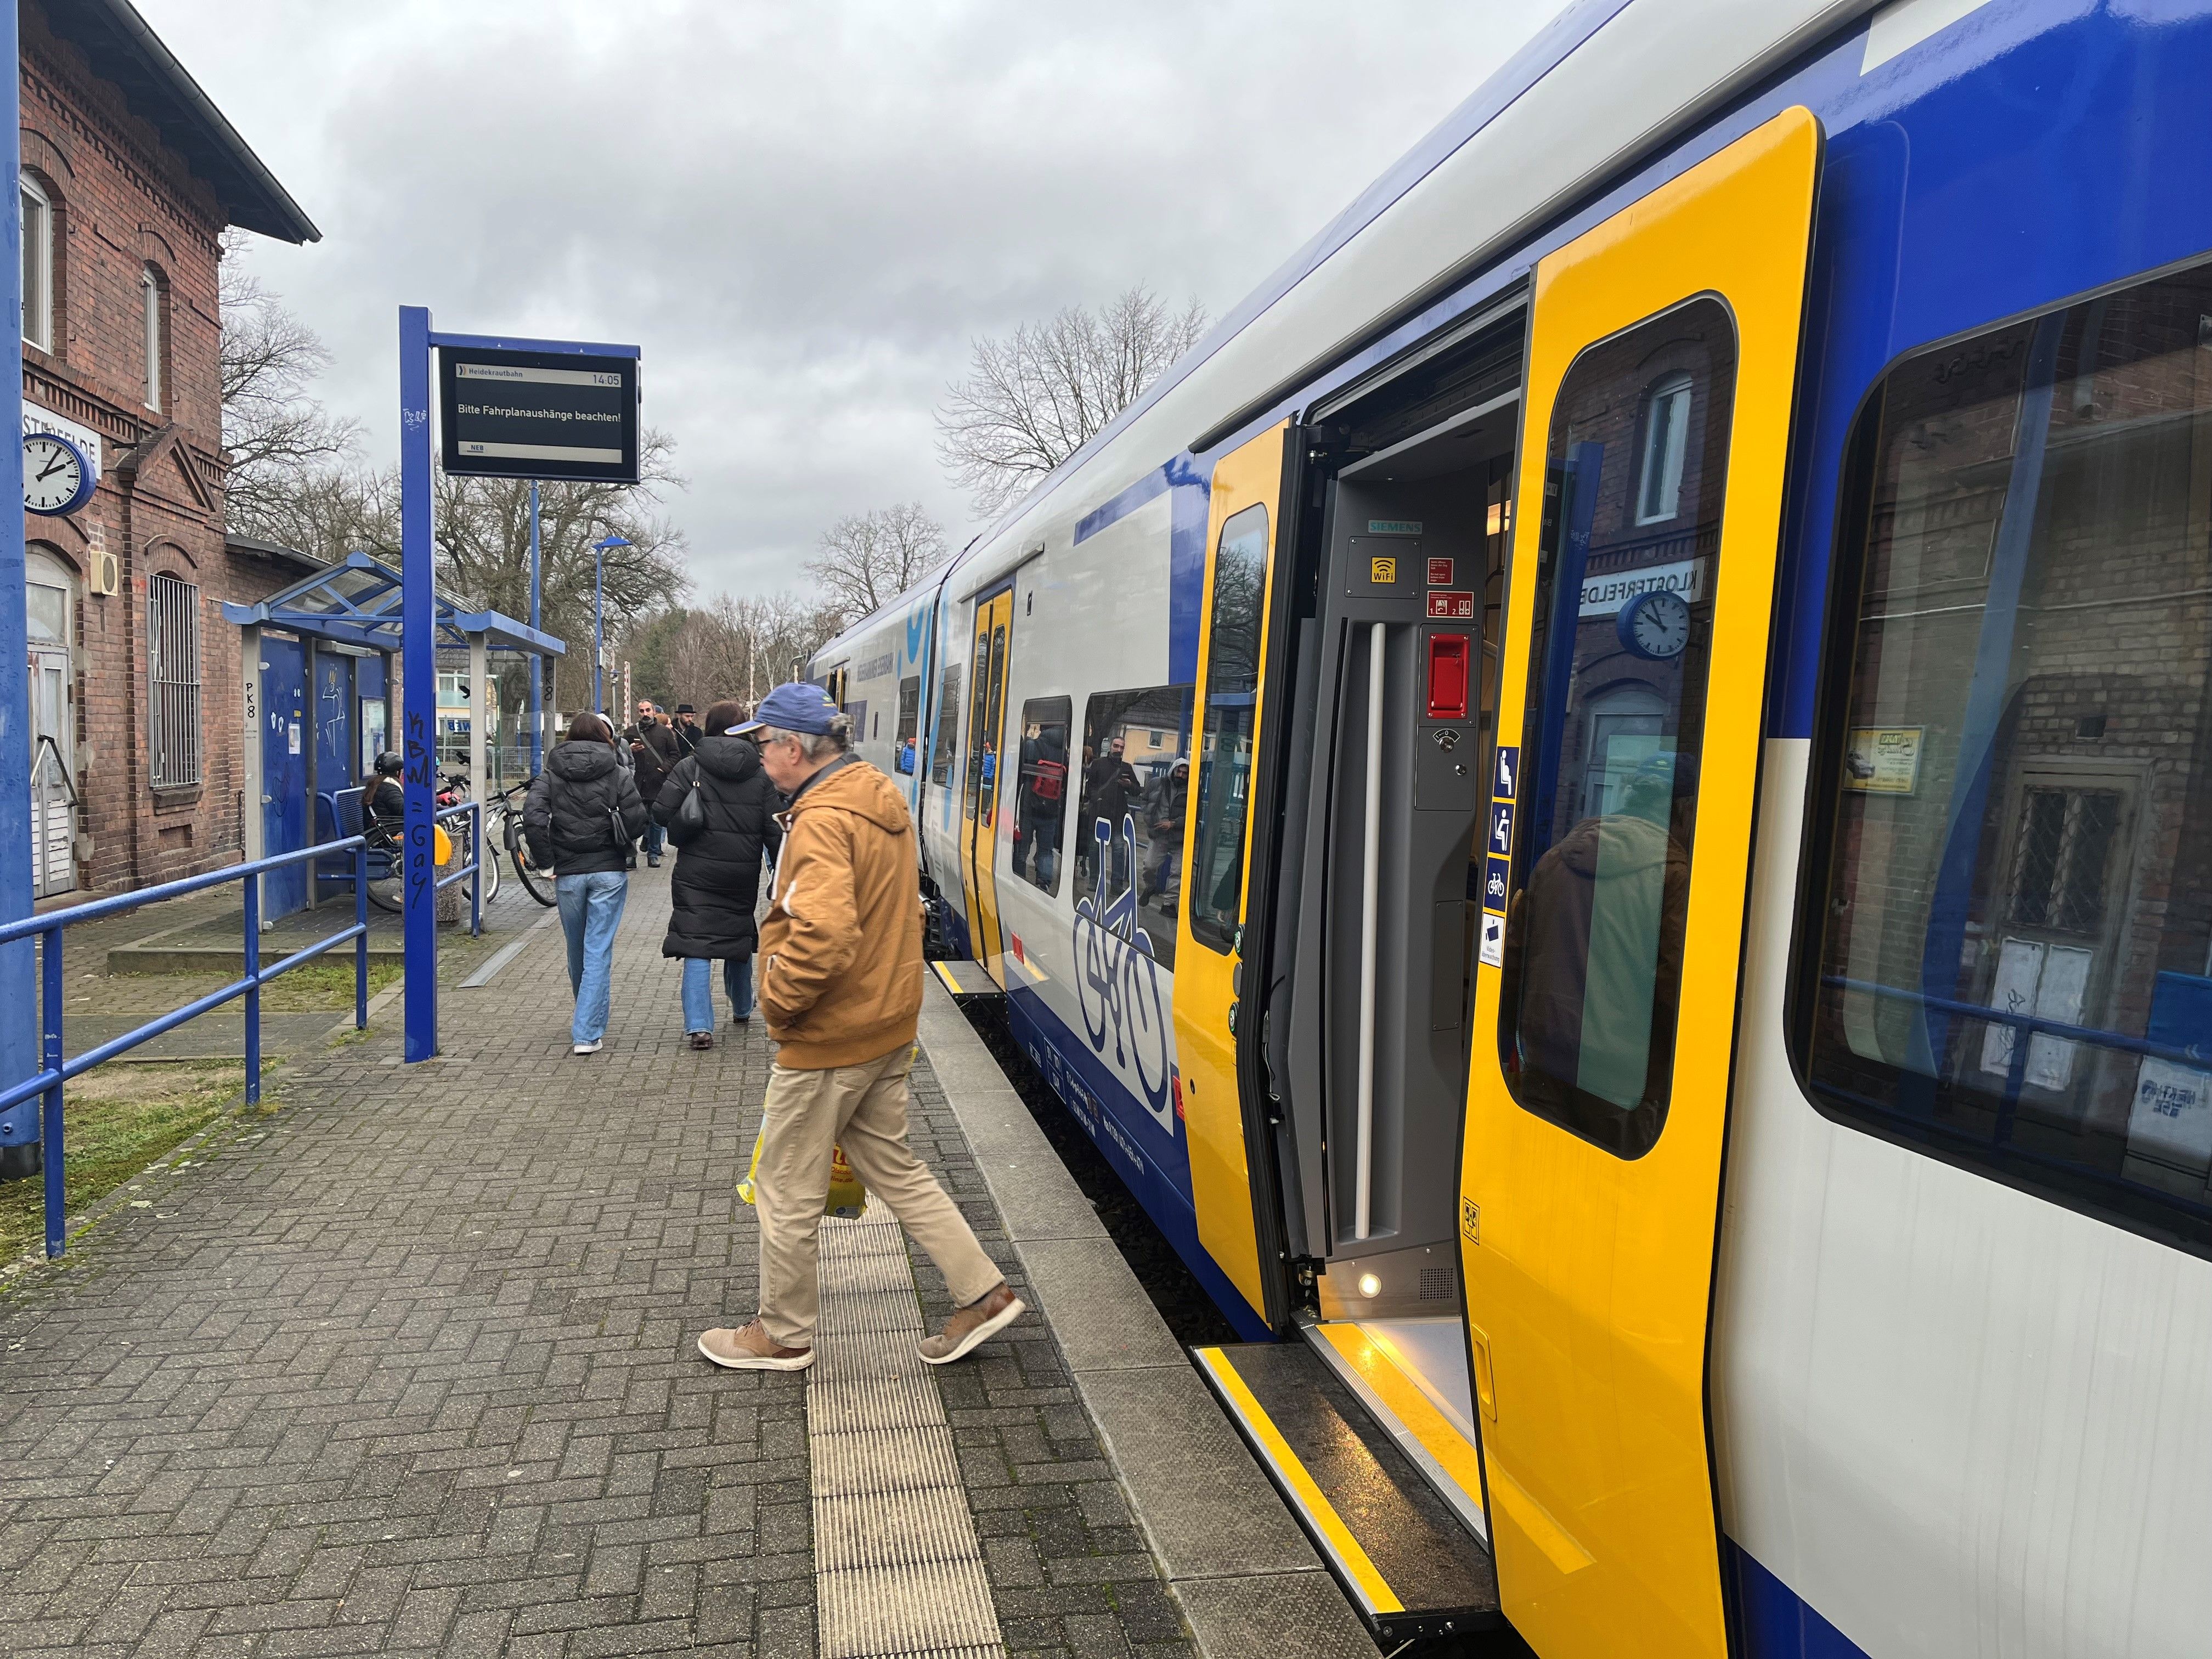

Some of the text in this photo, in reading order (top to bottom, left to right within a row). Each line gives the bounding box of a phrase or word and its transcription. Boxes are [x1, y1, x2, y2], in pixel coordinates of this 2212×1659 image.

[469, 368, 523, 377] Heidekrautbahn
[593, 374, 619, 385] 14:05
[458, 404, 621, 422] Bitte Fahrplanaushänge beachten!
[1370, 522, 1421, 532] SIEMENS
[1374, 572, 1393, 581] WiFi
[246, 682, 255, 718] PK8
